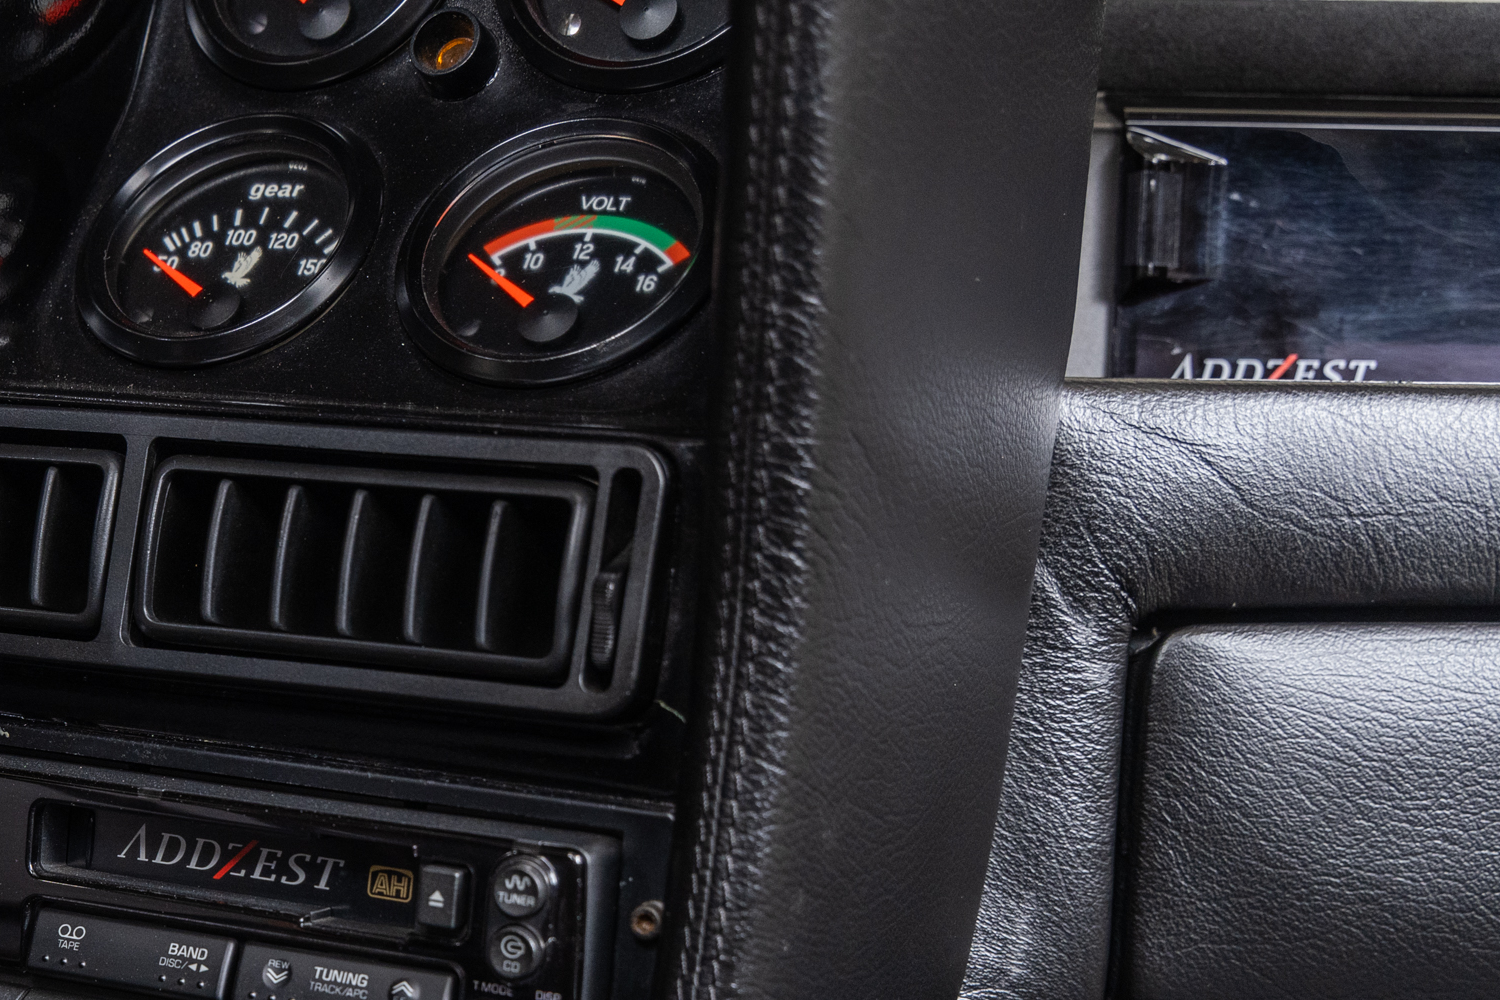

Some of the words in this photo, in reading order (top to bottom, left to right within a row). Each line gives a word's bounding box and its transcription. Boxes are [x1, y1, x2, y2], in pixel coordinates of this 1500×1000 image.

[249, 182, 304, 200] gear
[581, 195, 632, 211] VOLT
[188, 241, 213, 257] 80
[225, 229, 257, 246] 100
[268, 232, 299, 249] 120
[523, 253, 544, 270] 10
[572, 243, 594, 260] 12
[614, 255, 636, 273] 14
[635, 274, 658, 292] 16
[1170, 352, 1377, 381] ADDZEST
[117, 823, 345, 891] ADDZEST
[497, 891, 536, 907] TUNER
[58, 939, 81, 951] TAPE
[168, 943, 209, 961] BAND
[268, 959, 290, 970] REW
[503, 960, 520, 974] CD
[314, 966, 369, 987] TUNING
[309, 981, 368, 1000] TRACK/APC
[480, 981, 514, 998] MODE
